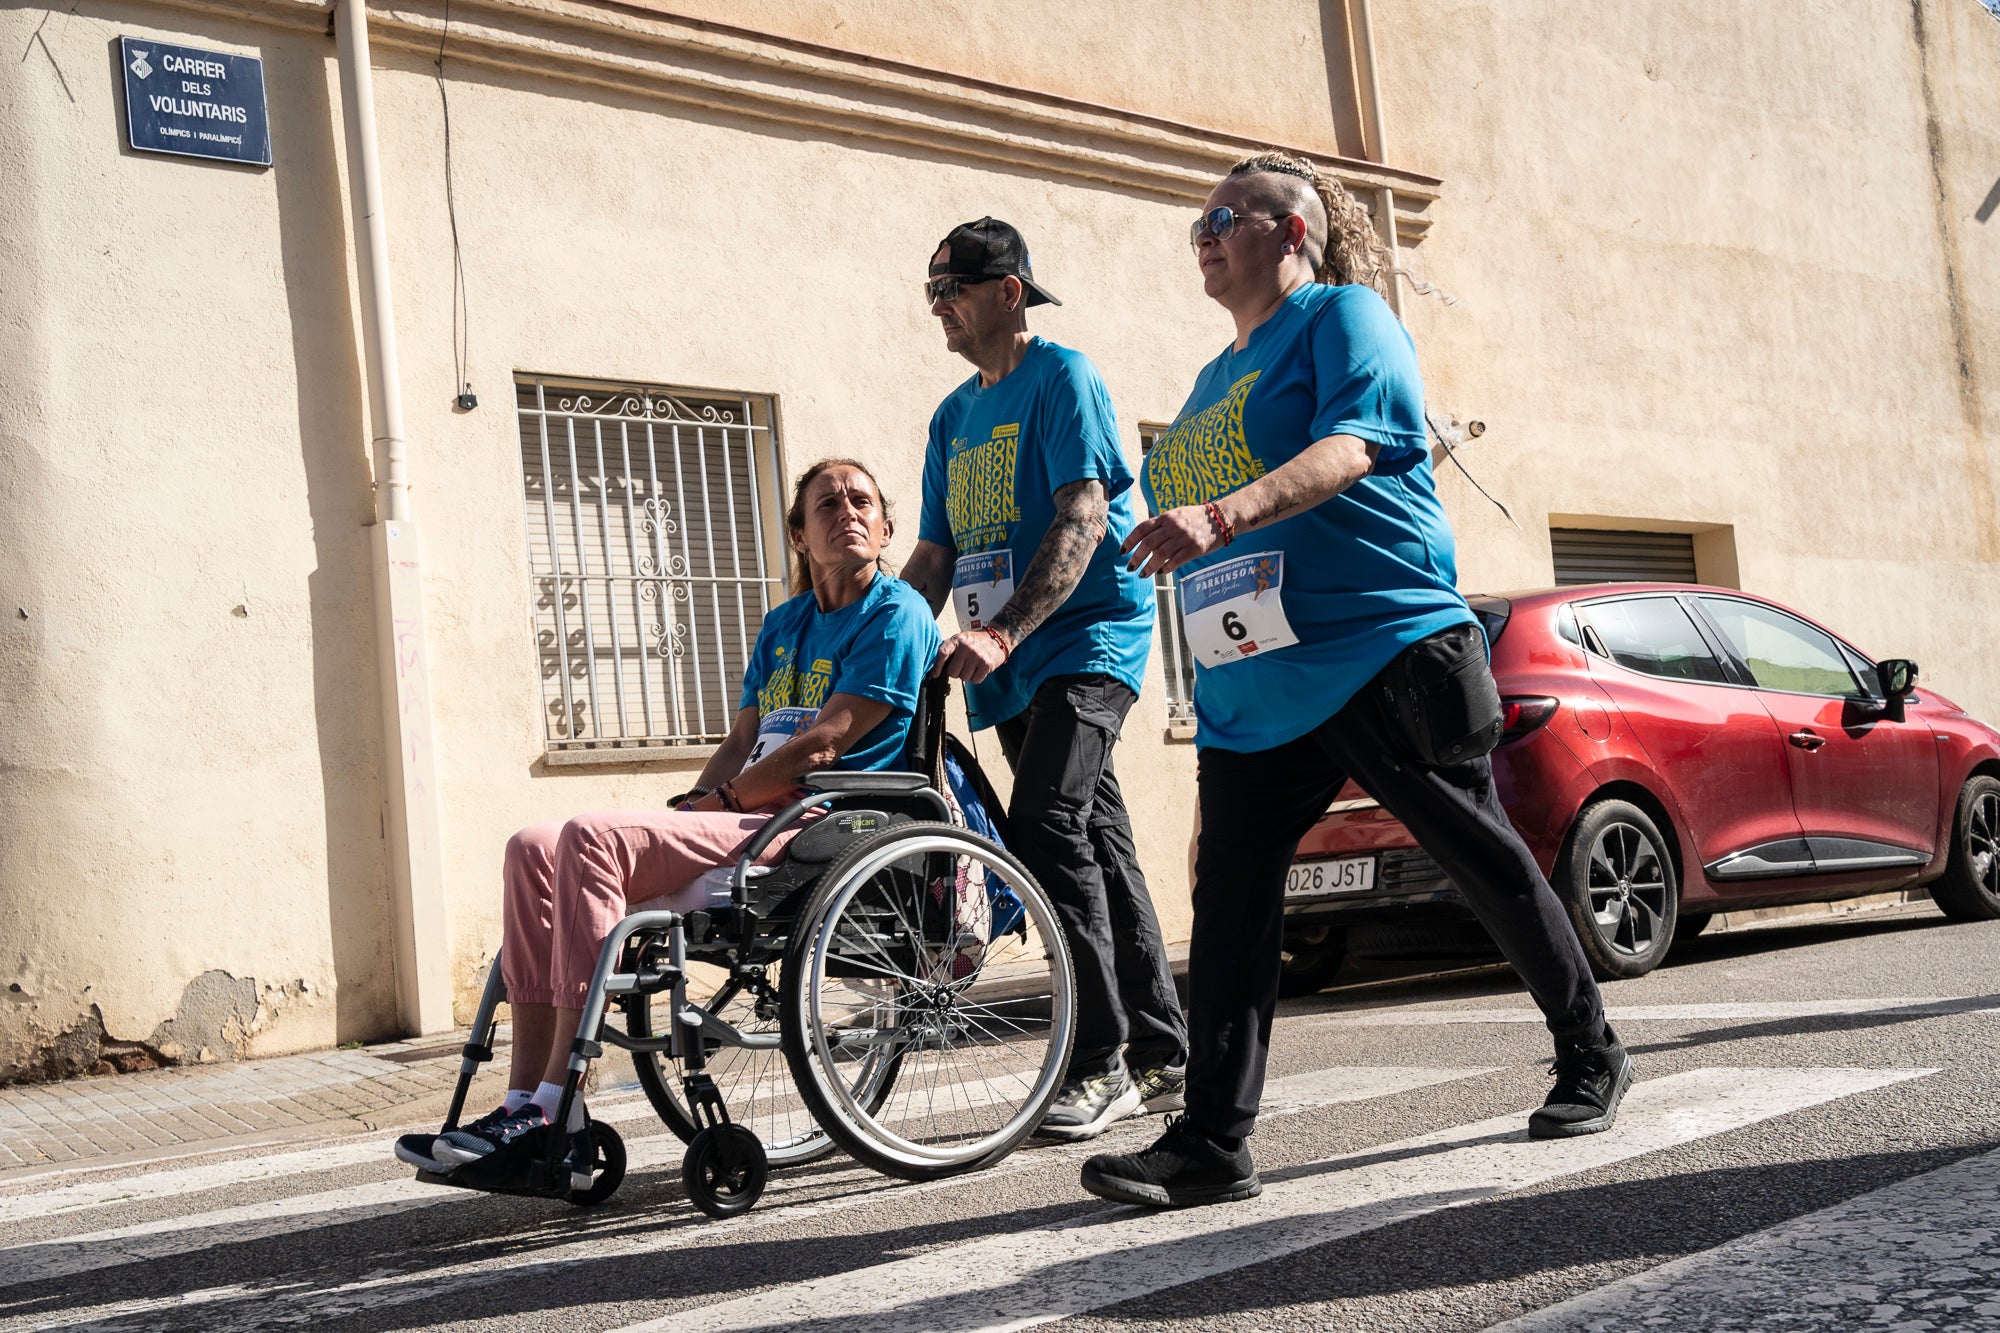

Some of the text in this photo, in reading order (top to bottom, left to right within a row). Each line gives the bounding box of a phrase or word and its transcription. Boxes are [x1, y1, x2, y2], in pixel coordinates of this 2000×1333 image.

[163, 54, 226, 80] CARRER
[181, 80, 212, 96] DELS
[149, 94, 247, 124] VOLUNTARIS
[160, 126, 191, 139] OLÍMPICS
[199, 132, 242, 145] PARALÍMPICS
[1195, 566, 1256, 593] PARKINSON
[967, 592, 980, 617] 5
[1222, 611, 1248, 641] 6
[749, 741, 766, 763] 4
[1286, 861, 1369, 892] 026 JST
